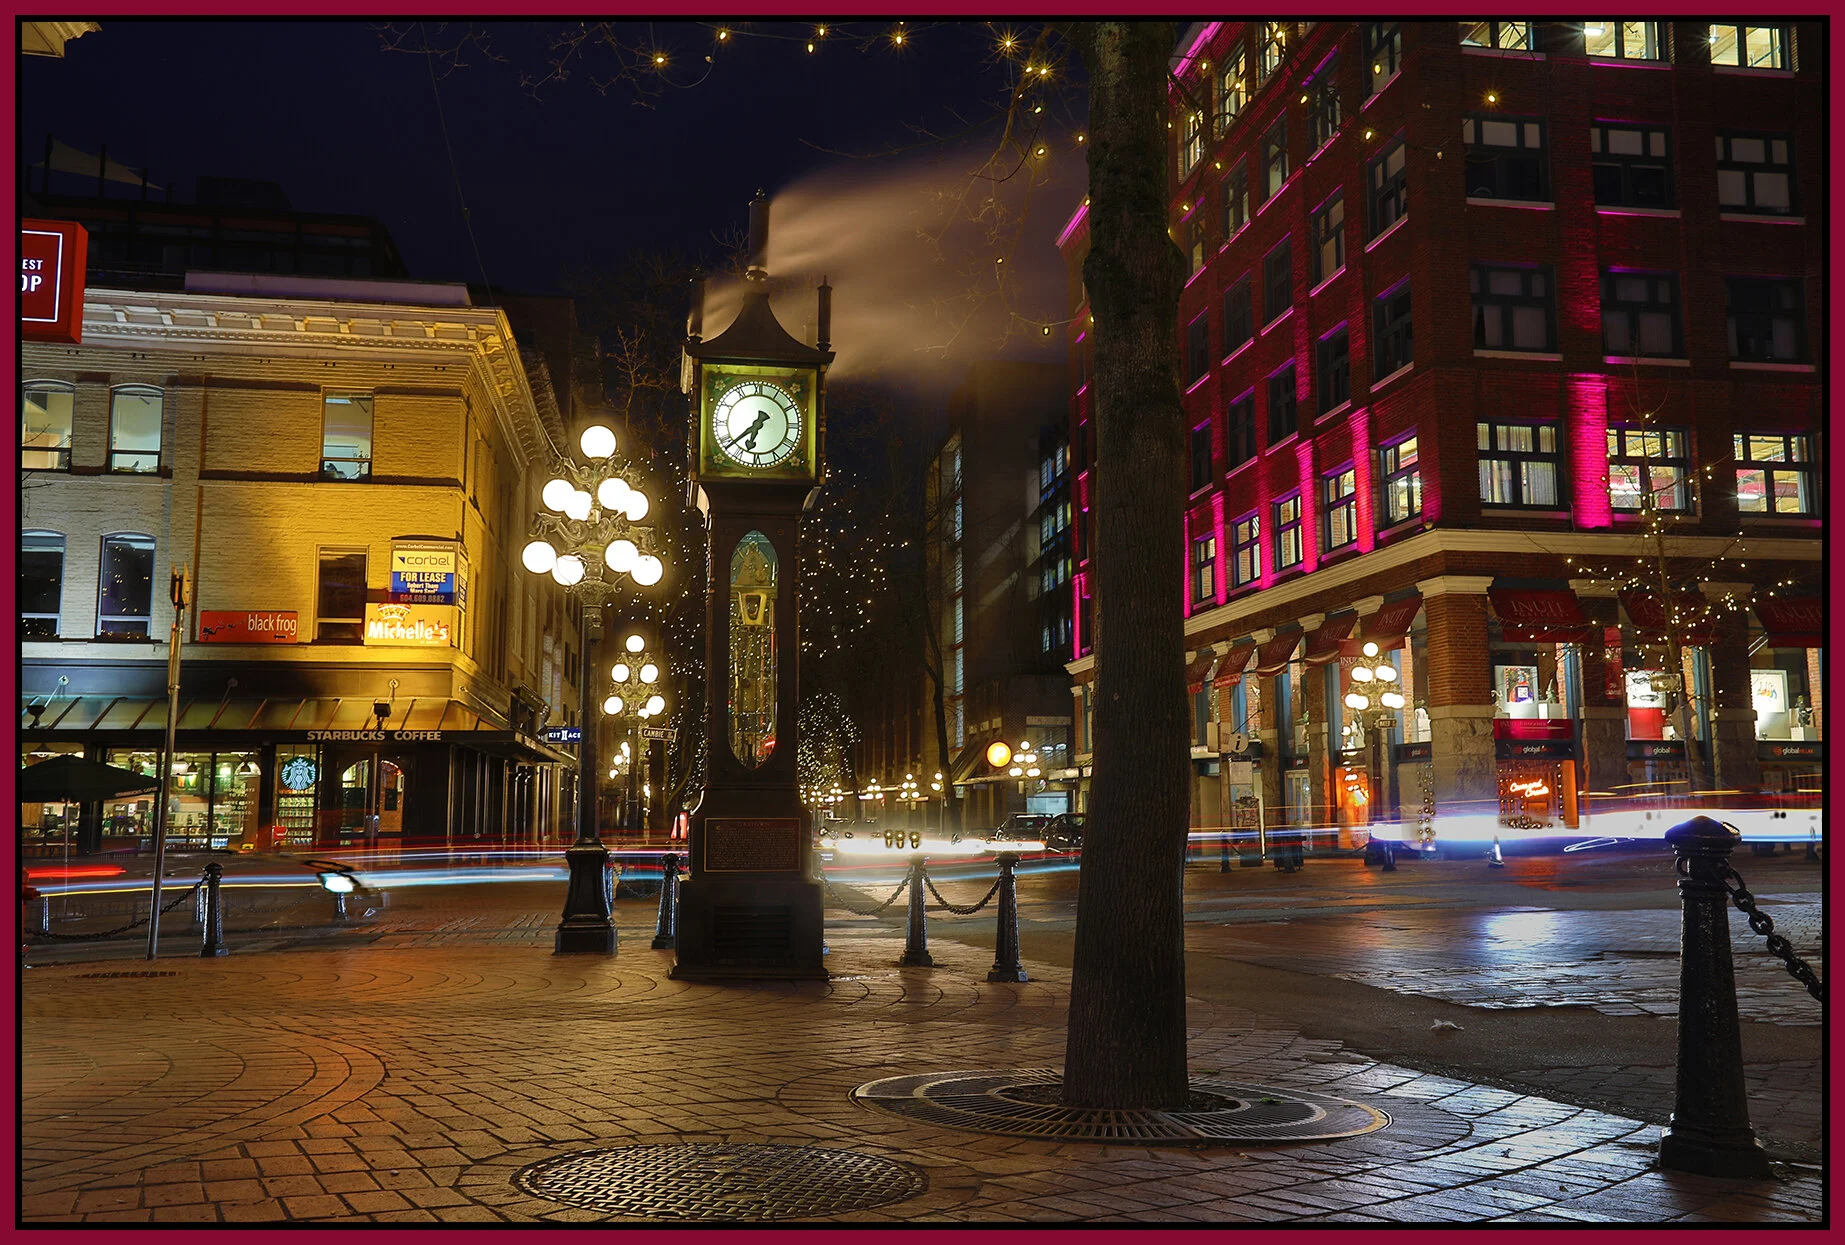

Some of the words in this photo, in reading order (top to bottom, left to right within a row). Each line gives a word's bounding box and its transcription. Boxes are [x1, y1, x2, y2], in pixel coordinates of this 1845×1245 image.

[407, 555, 450, 565] corbel
[400, 572, 418, 582] FOR
[419, 573, 446, 583] LEASE
[247, 613, 274, 631] black
[276, 614, 297, 636] frog
[368, 620, 449, 640] Michelle's
[307, 731, 385, 740] STARBUCKS
[394, 731, 442, 740] COFFEE
[643, 729, 665, 738] CAMBIE
